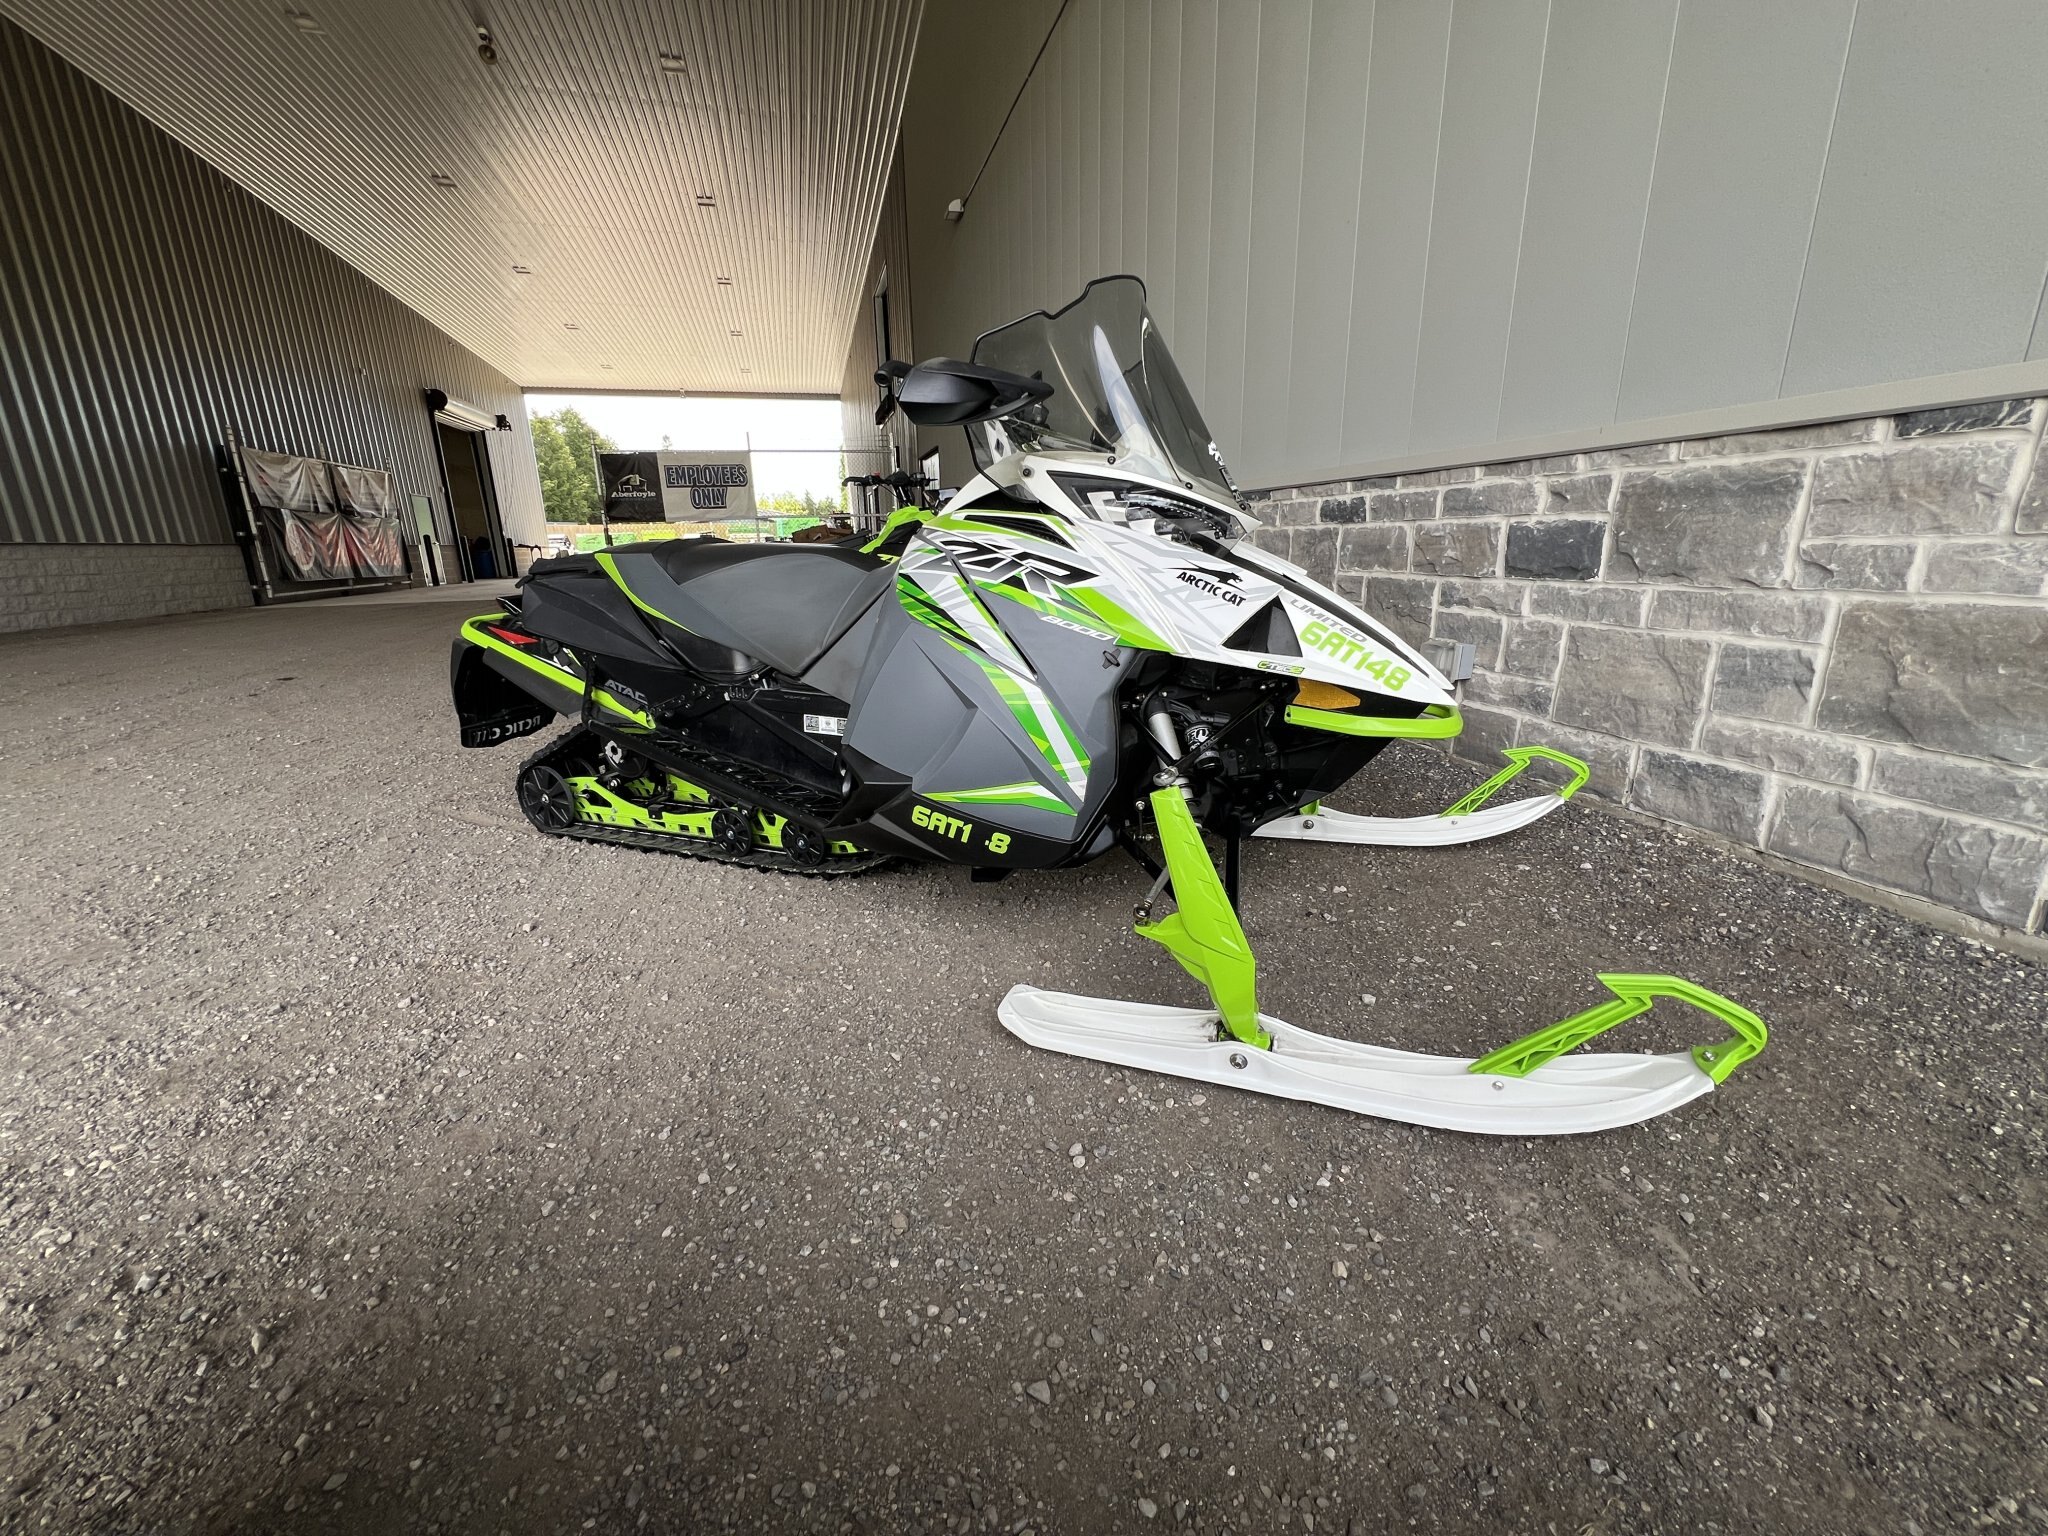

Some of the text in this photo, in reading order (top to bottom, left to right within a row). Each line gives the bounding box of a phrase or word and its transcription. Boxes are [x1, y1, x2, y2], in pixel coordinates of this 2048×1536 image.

[664, 464, 748, 488] EMPLOYEES
[690, 487, 727, 509] ONLY
[1176, 571, 1247, 607] ARCTIC CAT
[1040, 615, 1114, 641] 8000
[1290, 599, 1367, 643] LIMITED
[1300, 620, 1411, 692] 6AT148
[604, 679, 648, 704] ATAC
[911, 805, 1011, 854] 6AT18
